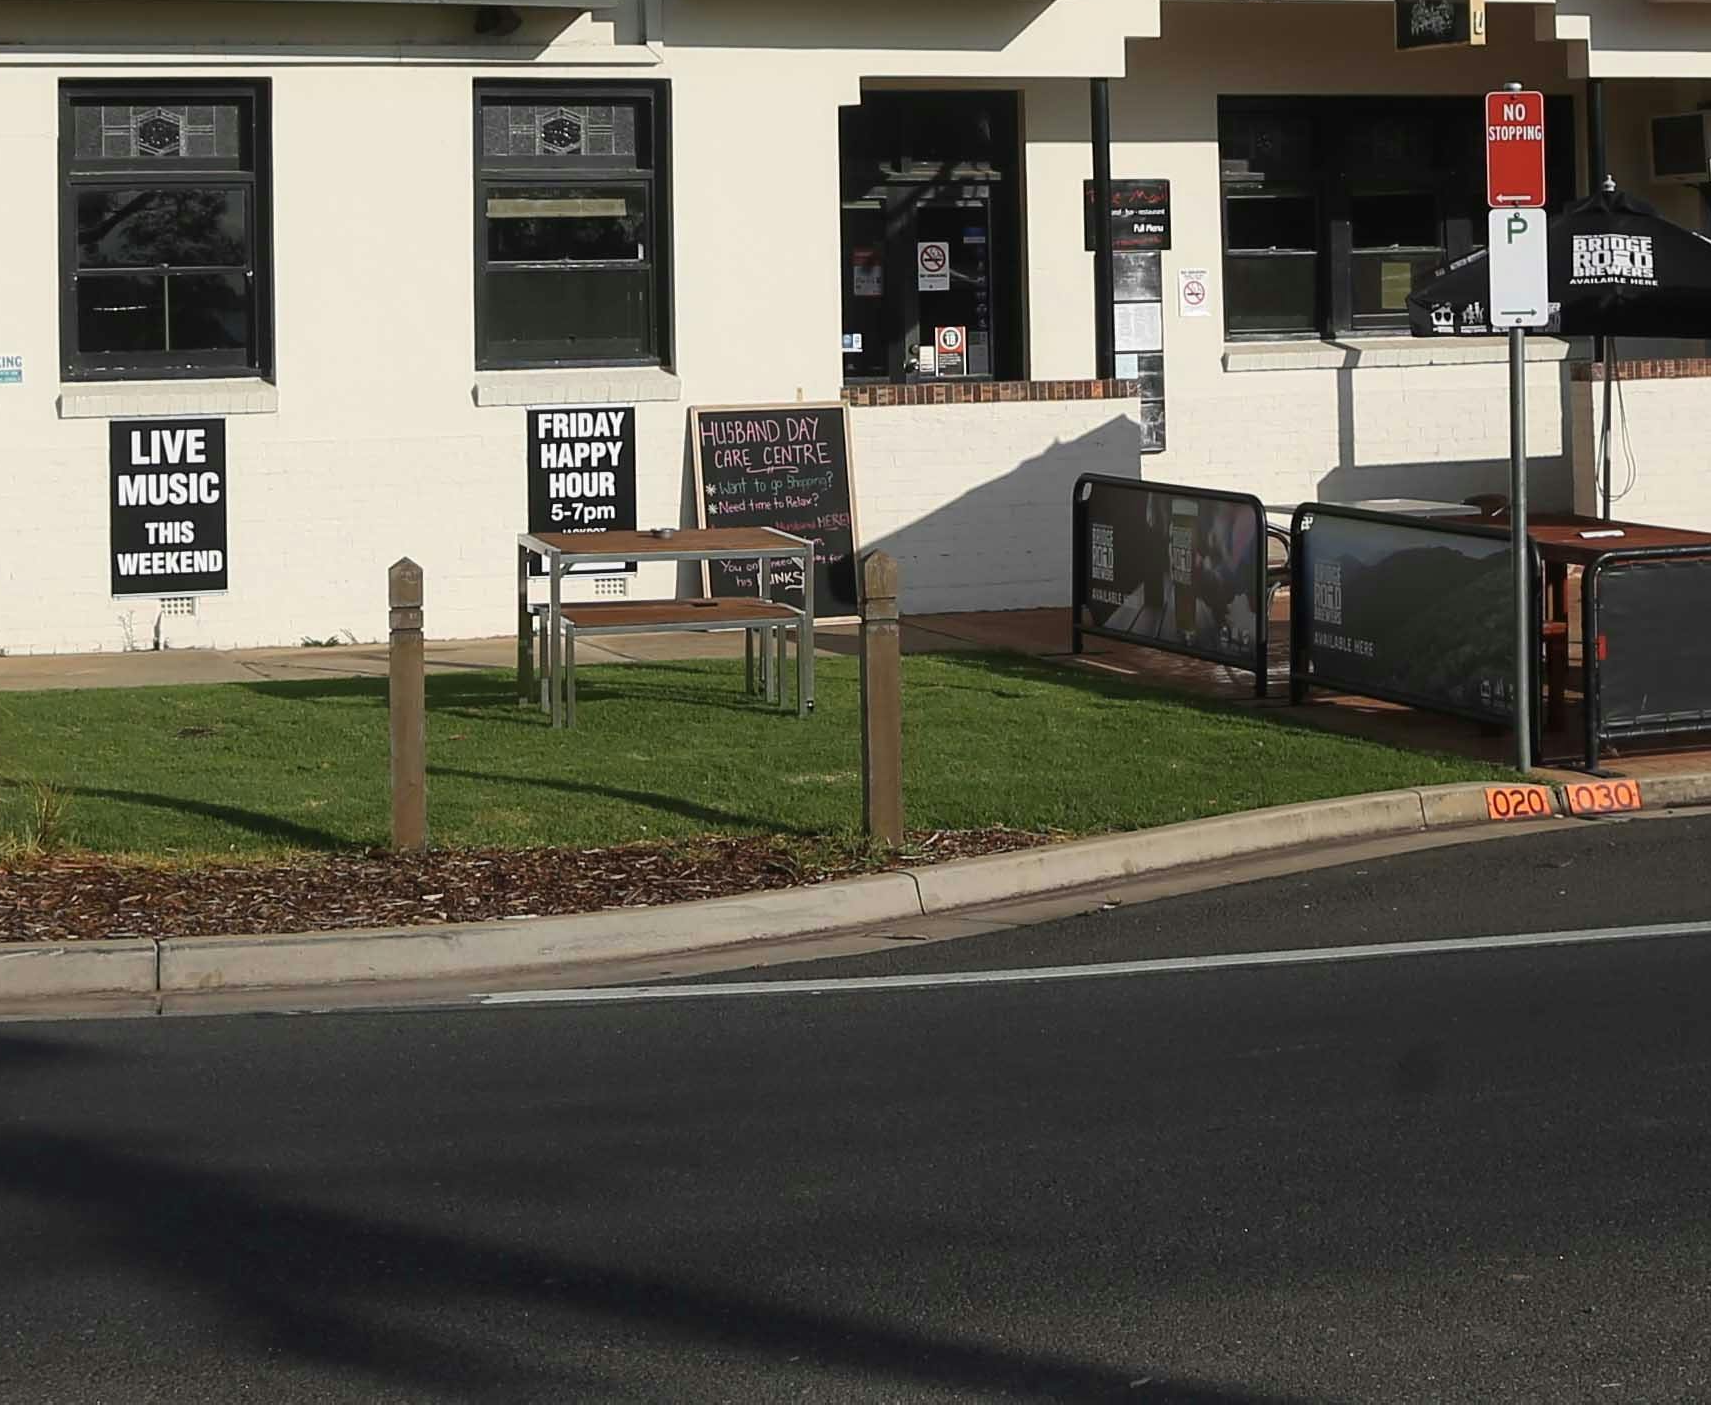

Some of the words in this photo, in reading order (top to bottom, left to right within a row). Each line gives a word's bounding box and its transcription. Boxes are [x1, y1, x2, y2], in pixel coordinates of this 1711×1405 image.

[1503, 103, 1526, 121] NO
[1488, 125, 1542, 141] STOPPING
[1507, 217, 1528, 244] P
[1573, 237, 1652, 253] BRIDGE
[1573, 250, 1653, 269] ROAD
[1569, 277, 1626, 285] AVAILABLE
[1630, 278, 1658, 286] HERE
[1573, 266, 1654, 278] BREWERS
[538, 411, 625, 439] FRIDAY
[700, 419, 781, 446] HUSBAND
[786, 416, 819, 442] DAY
[131, 429, 206, 465] LIVE
[540, 441, 623, 469] HAPPY
[714, 448, 753, 468] CARE
[763, 442, 832, 465] CENTRE
[118, 471, 220, 506] MUSIC
[549, 471, 616, 498] HOUR
[719, 477, 747, 495] Want
[754, 476, 766, 492] to
[770, 479, 783, 496] go
[551, 503, 616, 523] 5-7pm
[718, 499, 746, 515] Need
[749, 498, 771, 512] time
[773, 496, 785, 509] to
[785, 493, 819, 509] Relax?
[145, 520, 195, 545] THIS
[117, 549, 223, 576] WEEKEND
[721, 560, 742, 573] You
[736, 574, 753, 587] his
[1313, 631, 1352, 653] AVAILABLE
[1492, 789, 1544, 817] 020
[1575, 782, 1634, 811] 030
